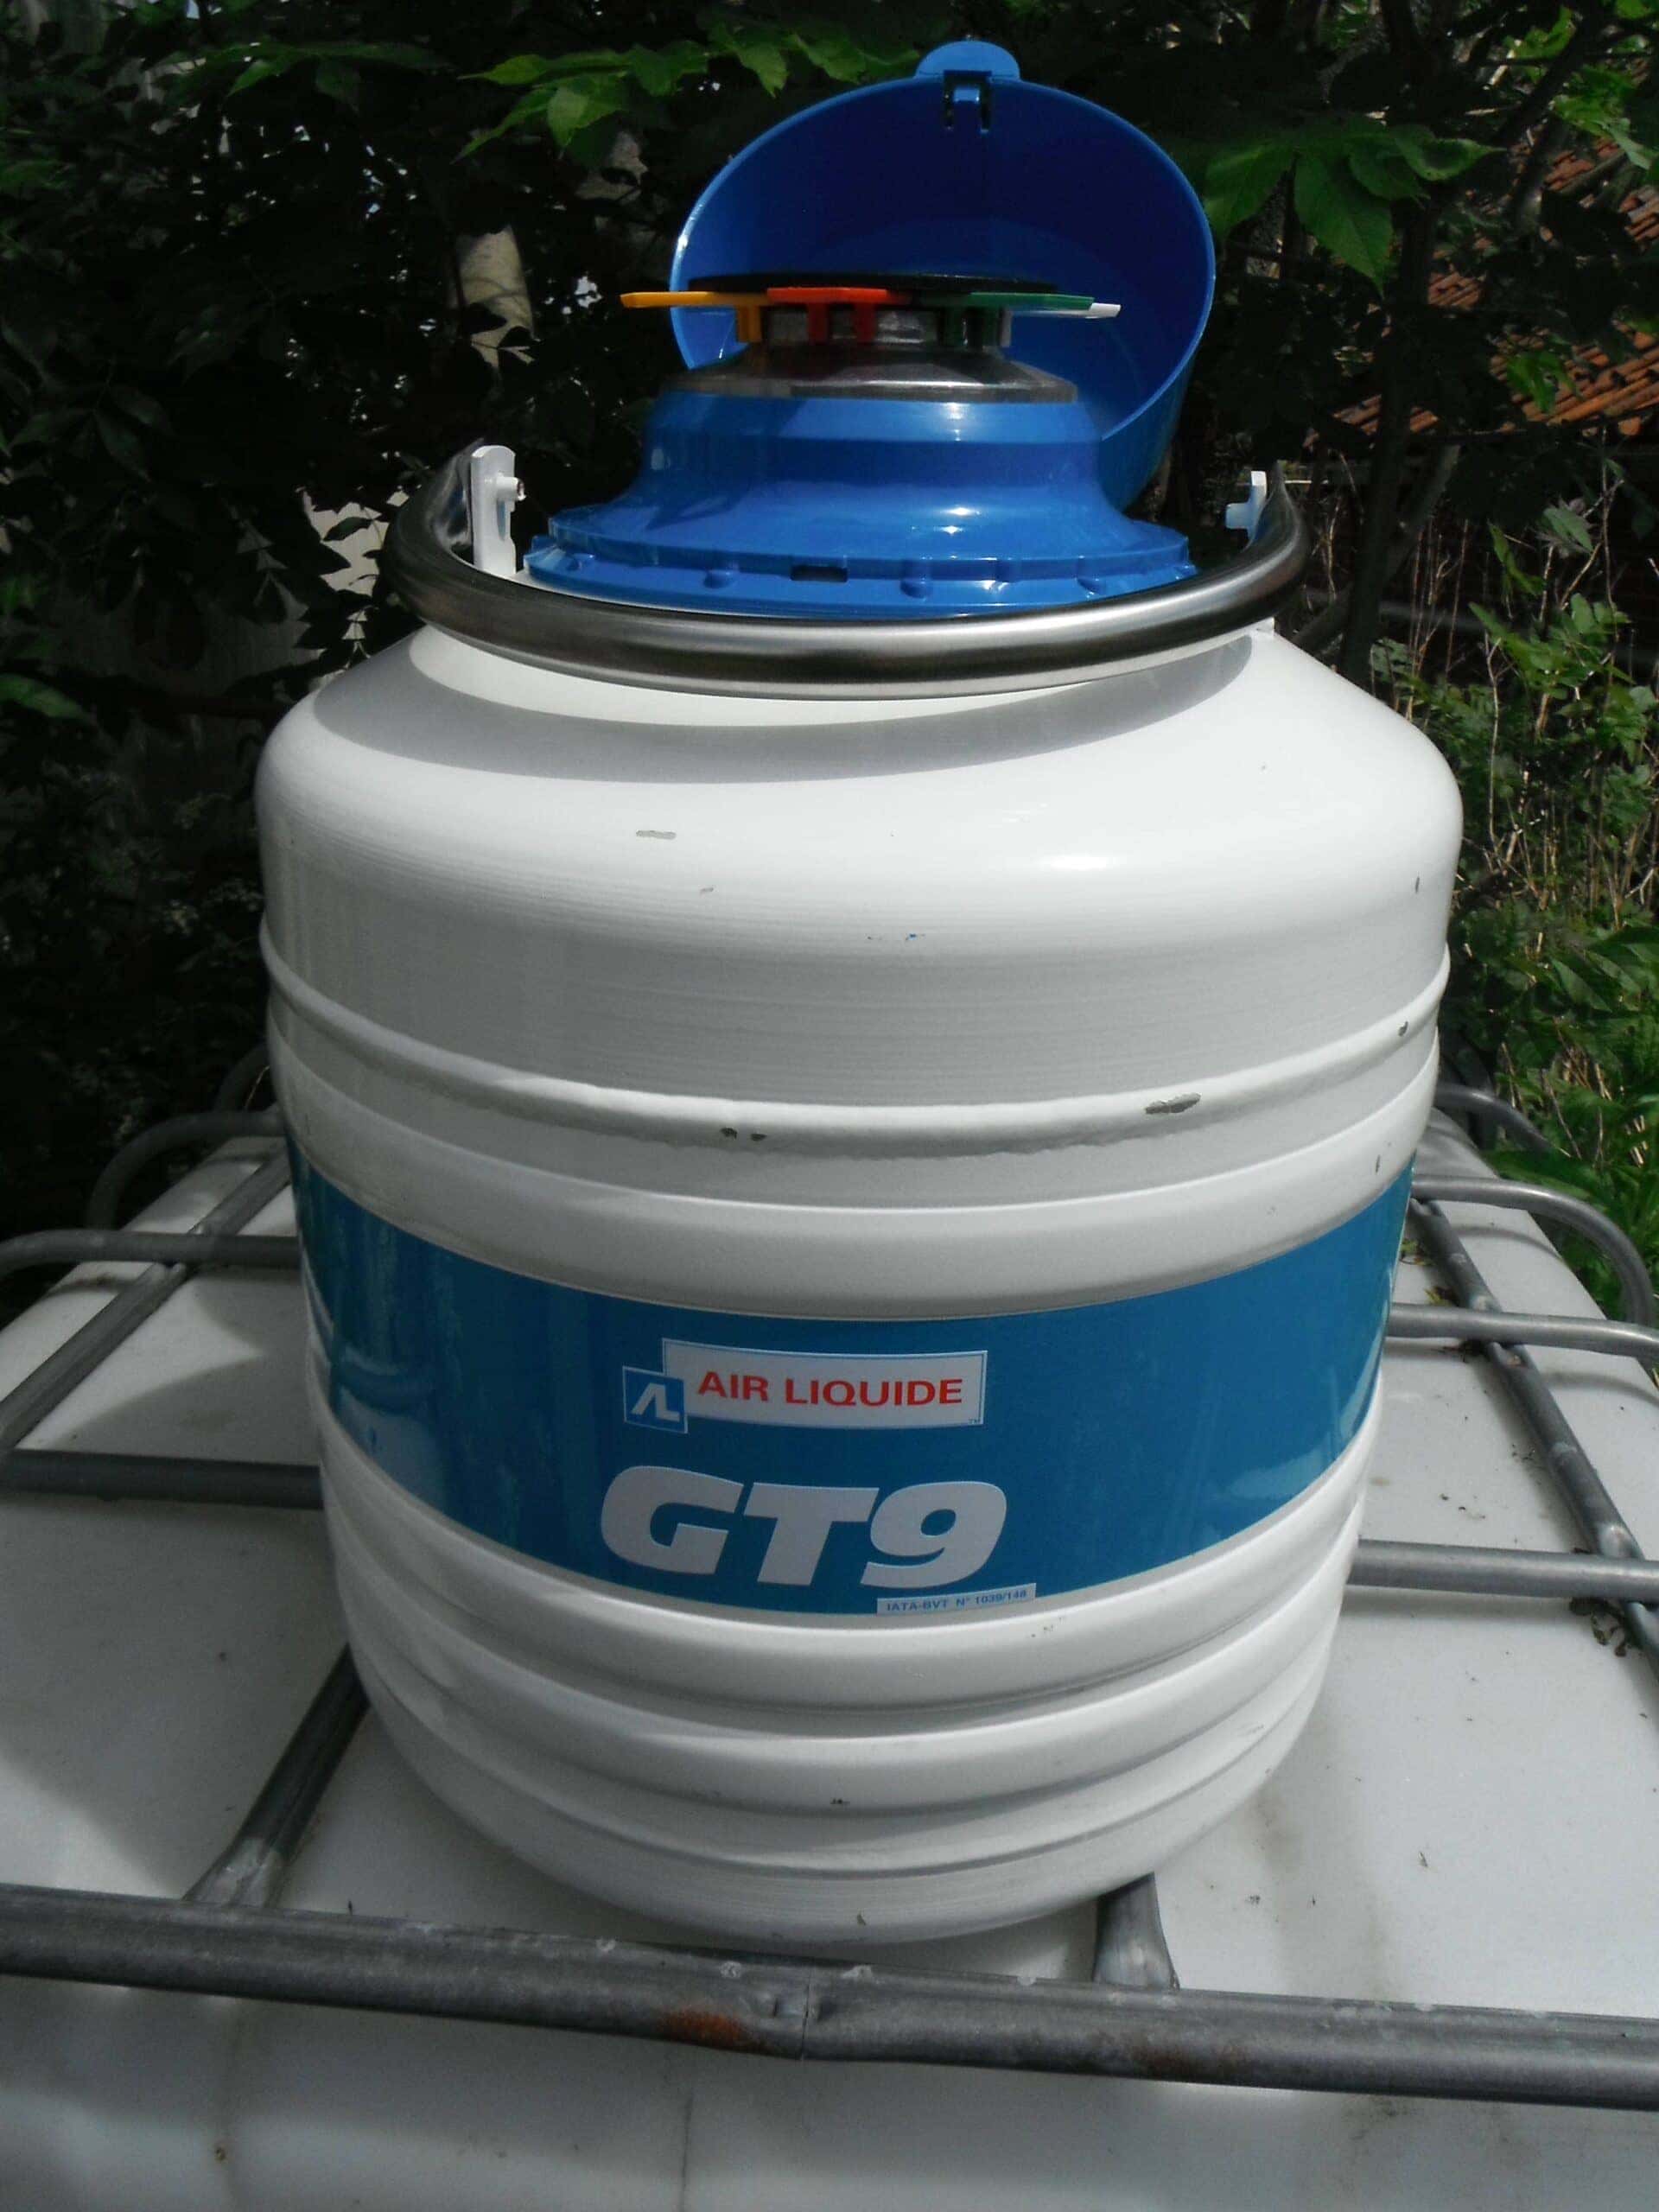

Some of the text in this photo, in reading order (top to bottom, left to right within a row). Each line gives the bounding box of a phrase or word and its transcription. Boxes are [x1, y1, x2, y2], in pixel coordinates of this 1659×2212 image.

[698, 1370, 963, 1407] AIR LIQUIDE
[601, 1465, 1008, 1588] GT9
